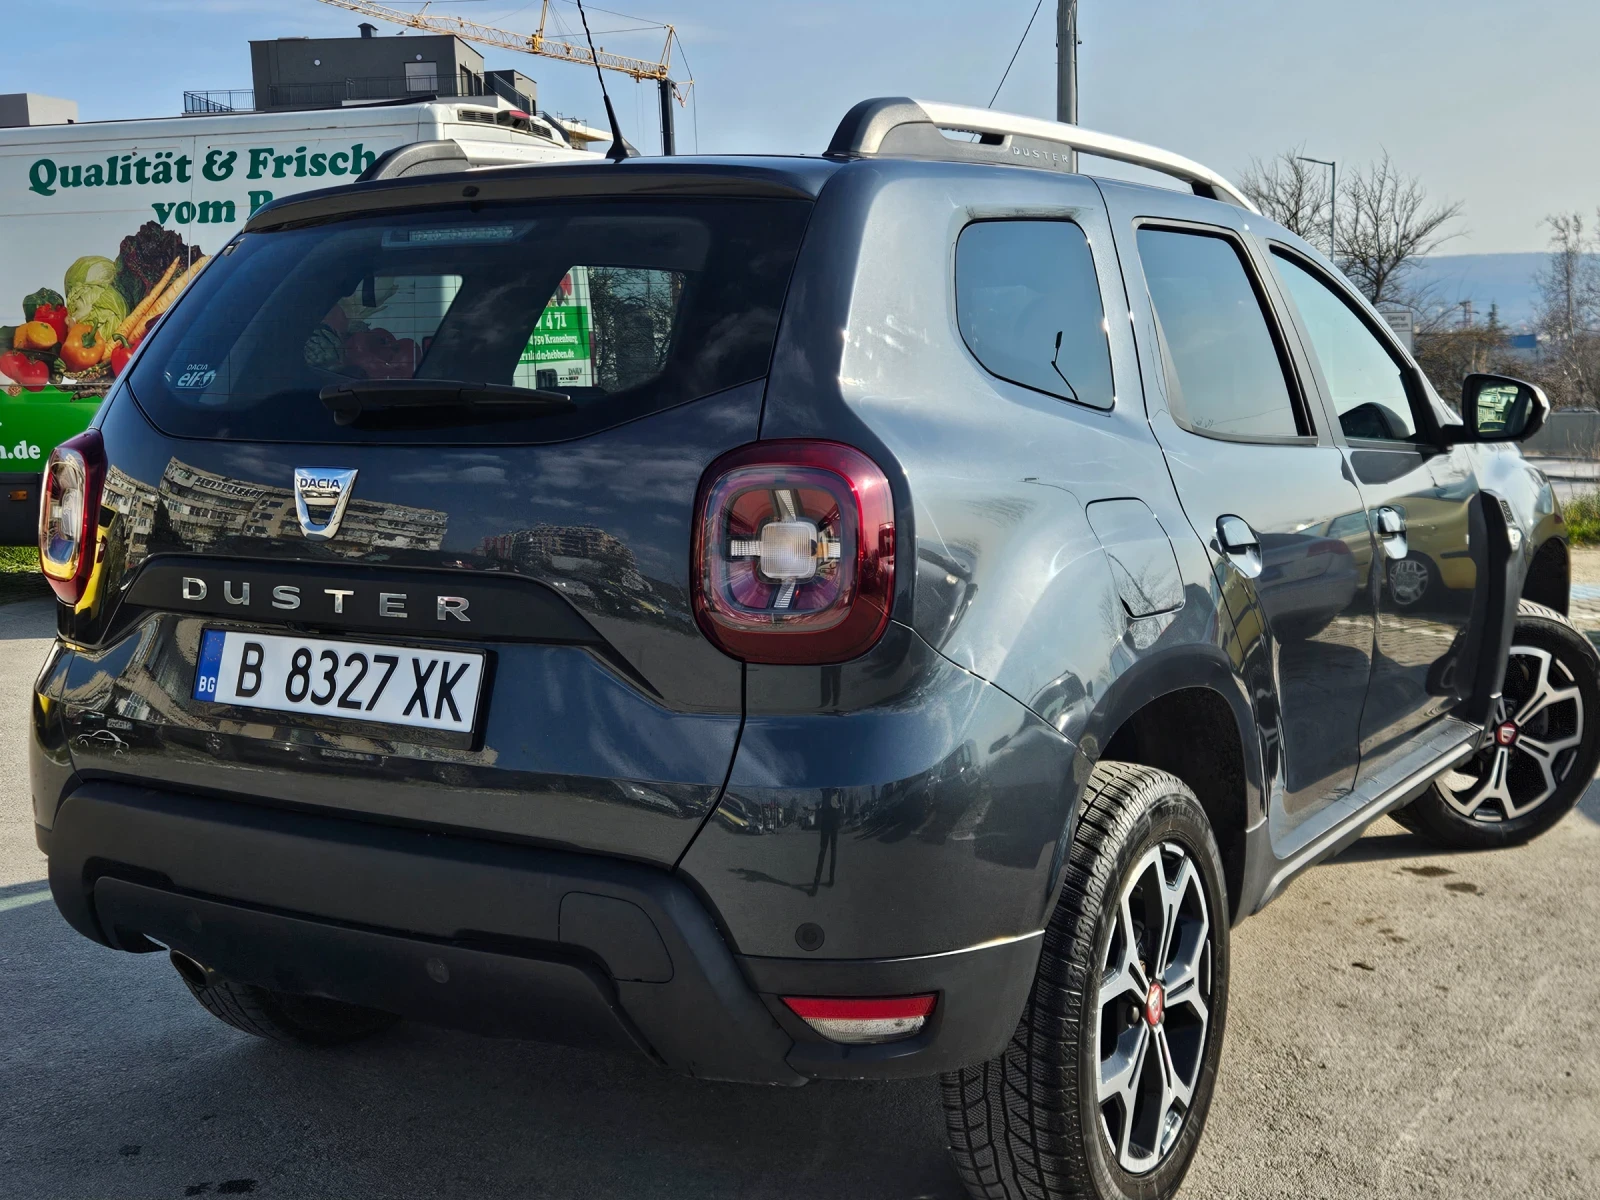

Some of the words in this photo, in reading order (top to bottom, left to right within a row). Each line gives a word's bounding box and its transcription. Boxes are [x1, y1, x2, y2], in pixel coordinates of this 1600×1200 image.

[1012, 146, 1069, 163] DUSTER
[29, 151, 192, 197] Qualität
[202, 150, 237, 182] &
[246, 143, 376, 180] Frisch
[151, 200, 236, 225] vom
[186, 363, 209, 371] DACIA
[300, 478, 341, 489] DACIA
[182, 577, 472, 622] DUSTER
[198, 675, 215, 694] BG
[235, 642, 264, 698] B
[285, 647, 399, 711] 8327
[402, 657, 470, 722] XK
